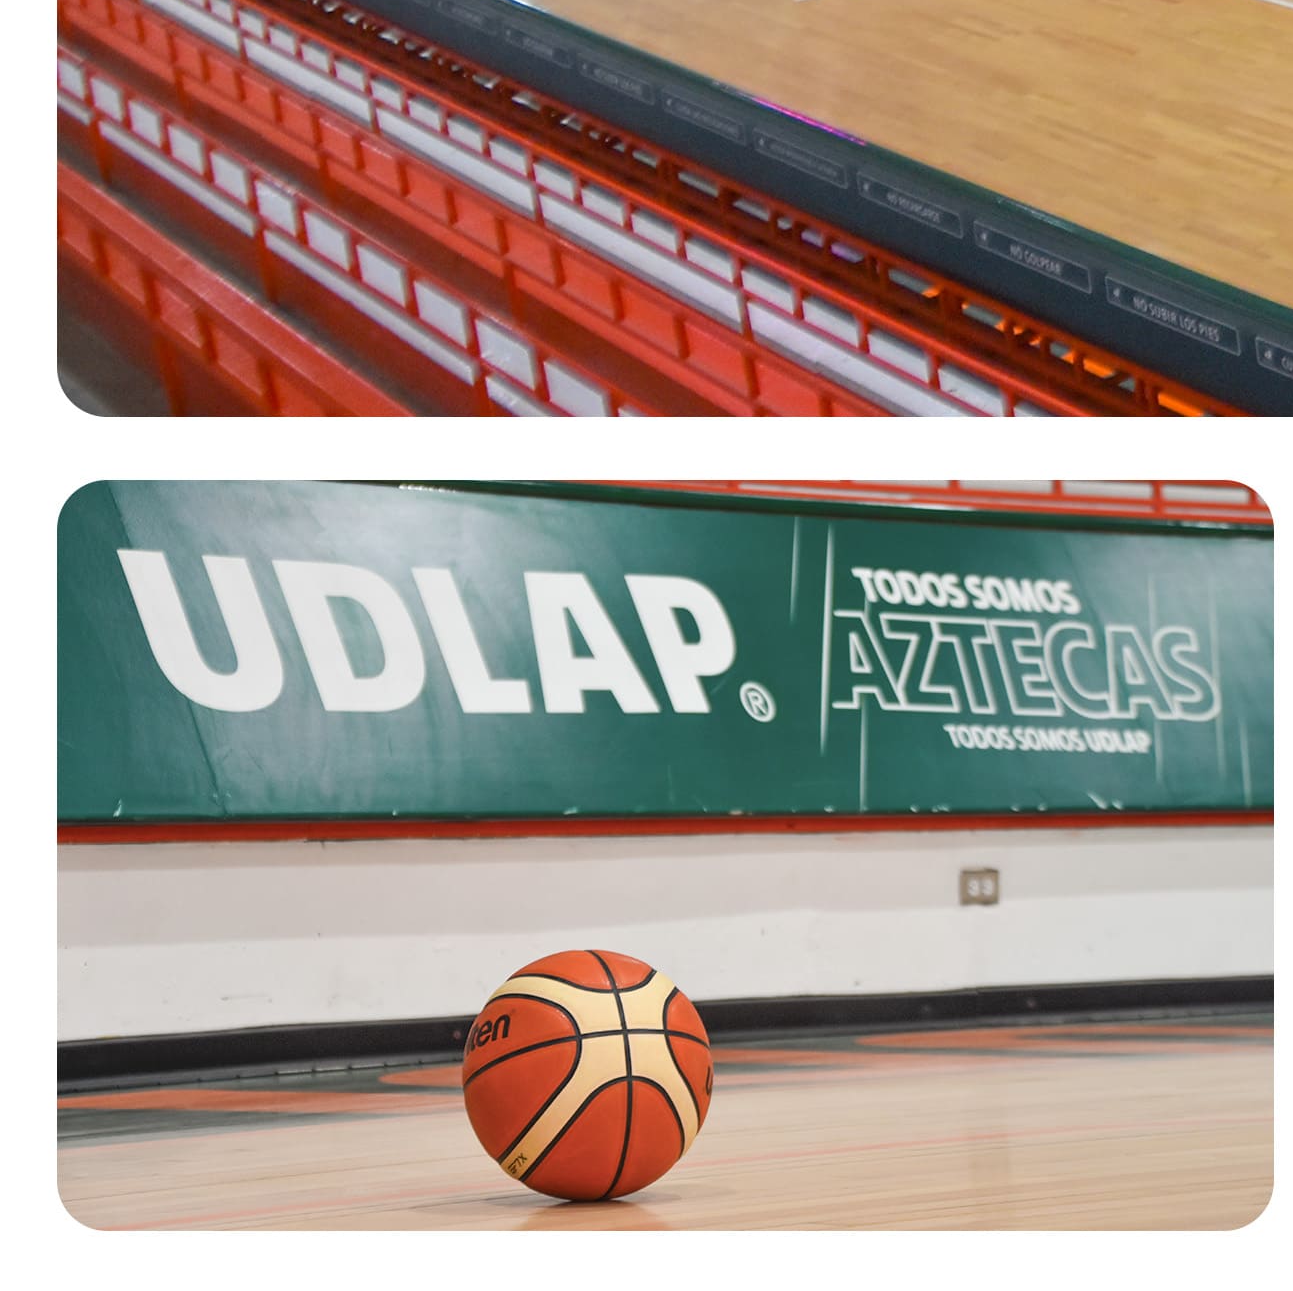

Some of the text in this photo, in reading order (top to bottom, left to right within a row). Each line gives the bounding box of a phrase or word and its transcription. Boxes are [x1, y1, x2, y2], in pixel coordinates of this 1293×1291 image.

[1133, 296, 1220, 342] NO SUBIR LOS PIES
[852, 566, 1082, 615] TODOS SOMOS
[116, 549, 737, 714] UDLAP
[832, 611, 1222, 722] AZTECAS
[944, 724, 1152, 754] TODOS SOMOS UDLAP
